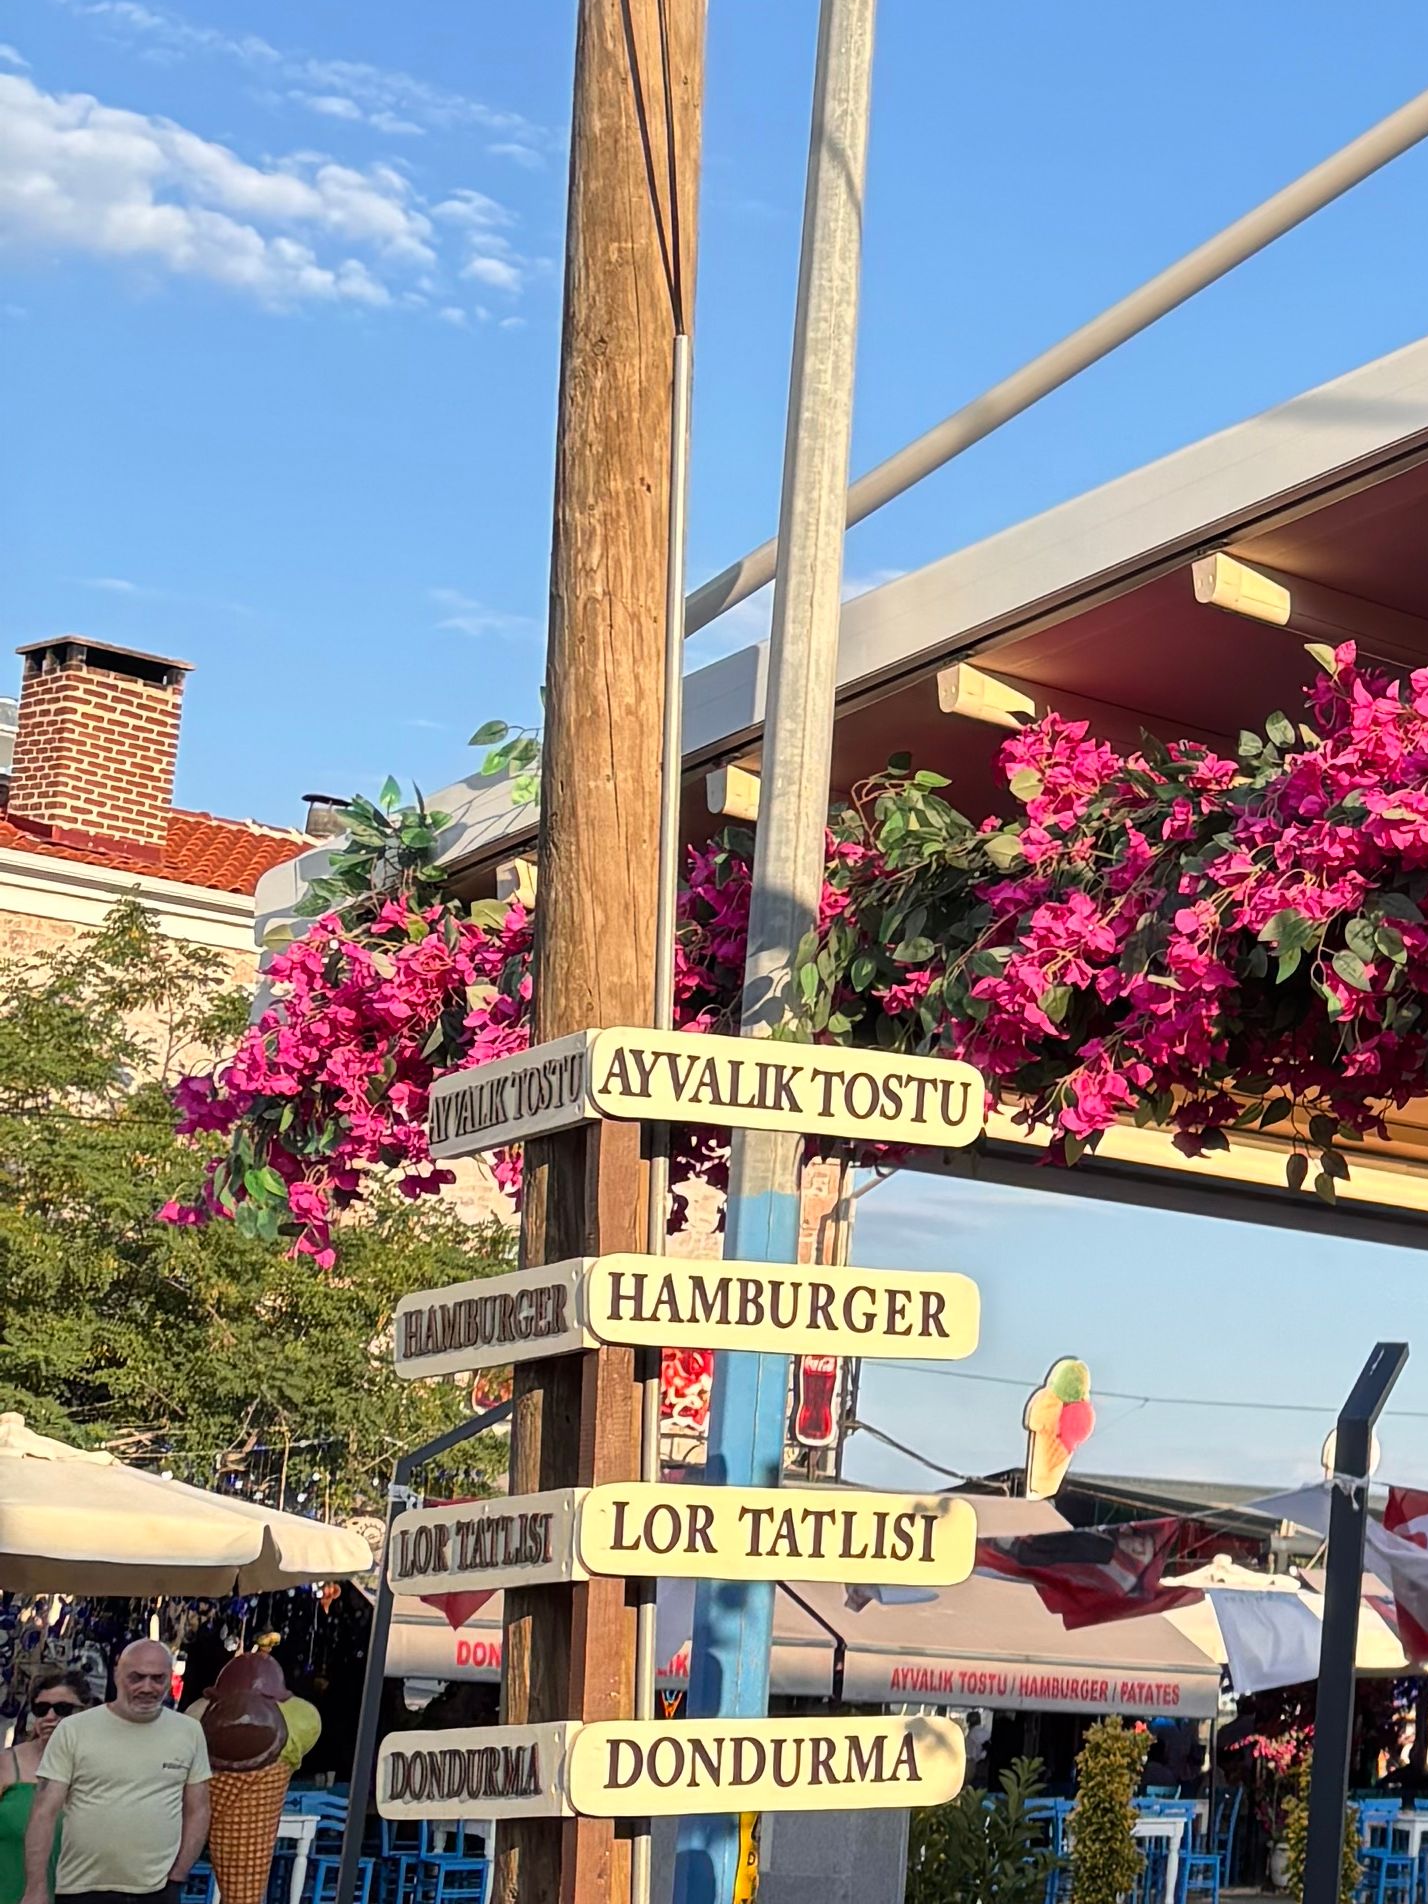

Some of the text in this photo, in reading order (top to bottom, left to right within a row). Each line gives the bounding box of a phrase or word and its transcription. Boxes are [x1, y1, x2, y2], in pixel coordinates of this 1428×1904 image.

[427, 1051, 585, 1146] AYVALIK TOSTU
[597, 1046, 972, 1128] AYVALIK TOSTU
[403, 1283, 569, 1359] HAMBURGER
[606, 1271, 951, 1339] HAMBURGER
[397, 1522, 449, 1578] LOR
[608, 1500, 939, 1563] LOR TATLISI
[890, 1667, 954, 1694] AYVALIK
[958, 1671, 1008, 1695] TOSTU
[1018, 1676, 1109, 1704] HAMBURGER
[1119, 1681, 1181, 1706] PATATES
[387, 1742, 543, 1802] DONDURMA
[603, 1732, 923, 1790] DONDURMA
